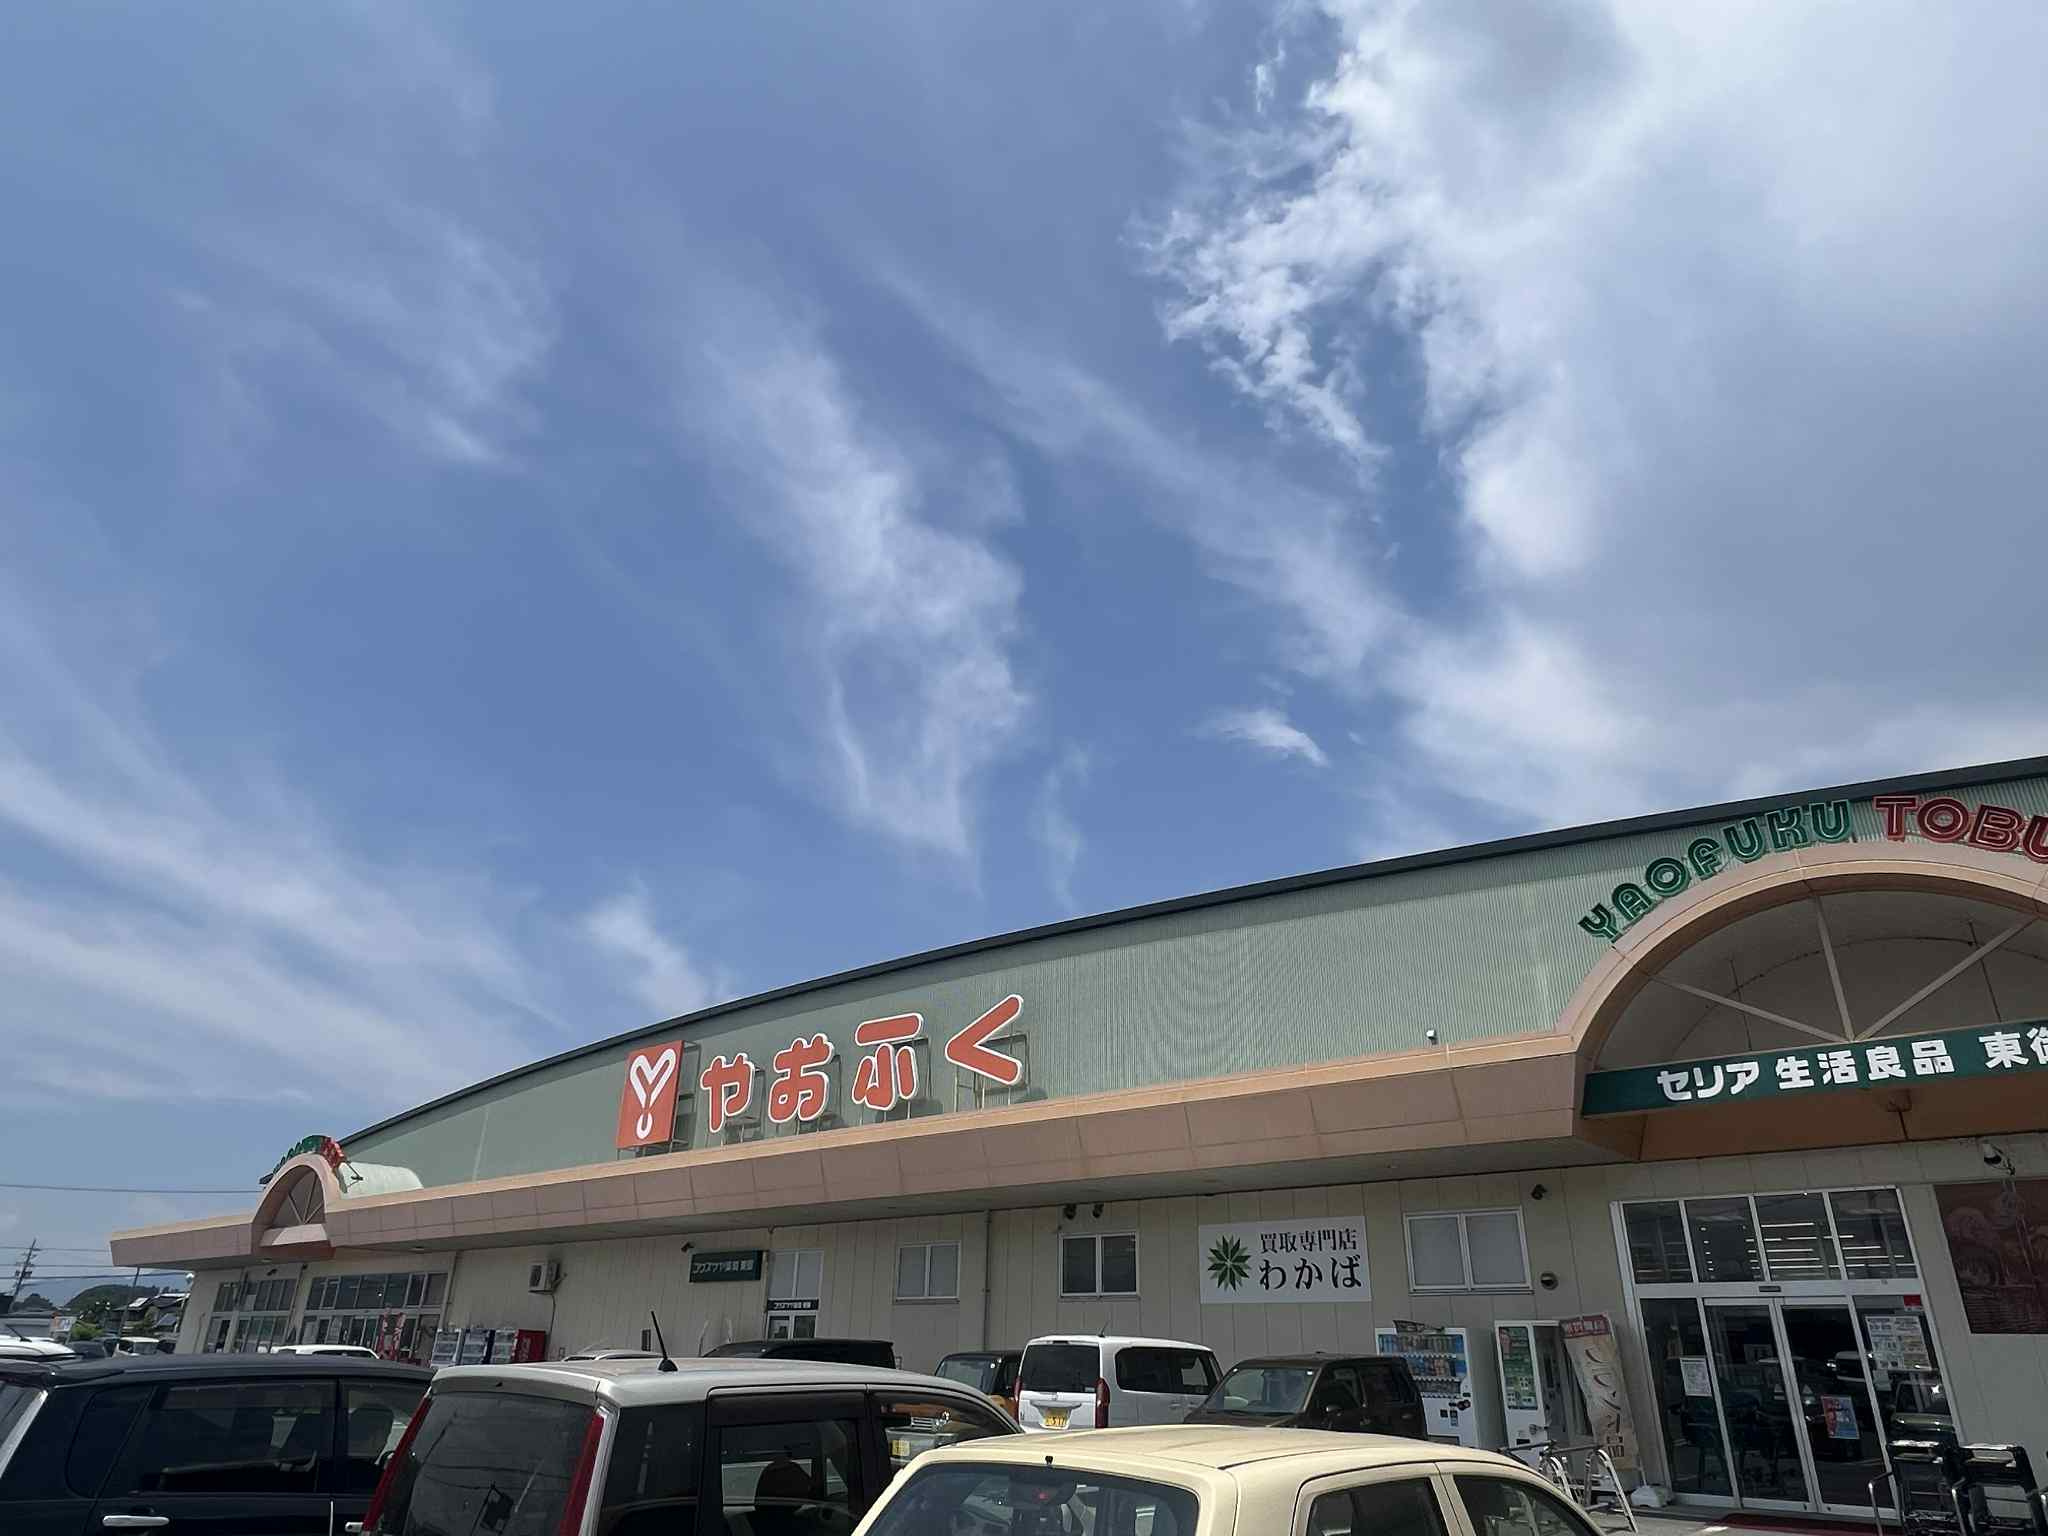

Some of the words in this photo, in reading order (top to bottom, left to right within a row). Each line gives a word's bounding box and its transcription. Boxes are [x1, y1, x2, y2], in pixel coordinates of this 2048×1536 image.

[1578, 799, 1852, 943] YAOFUKU
[700, 994, 1024, 1134] やおふく
[1656, 1061, 1760, 1102] セリア
[1775, 1039, 1955, 1091] 生活良品
[1259, 1254, 1362, 1291] わかば
[1260, 1228, 1358, 1254] 買取専門店
